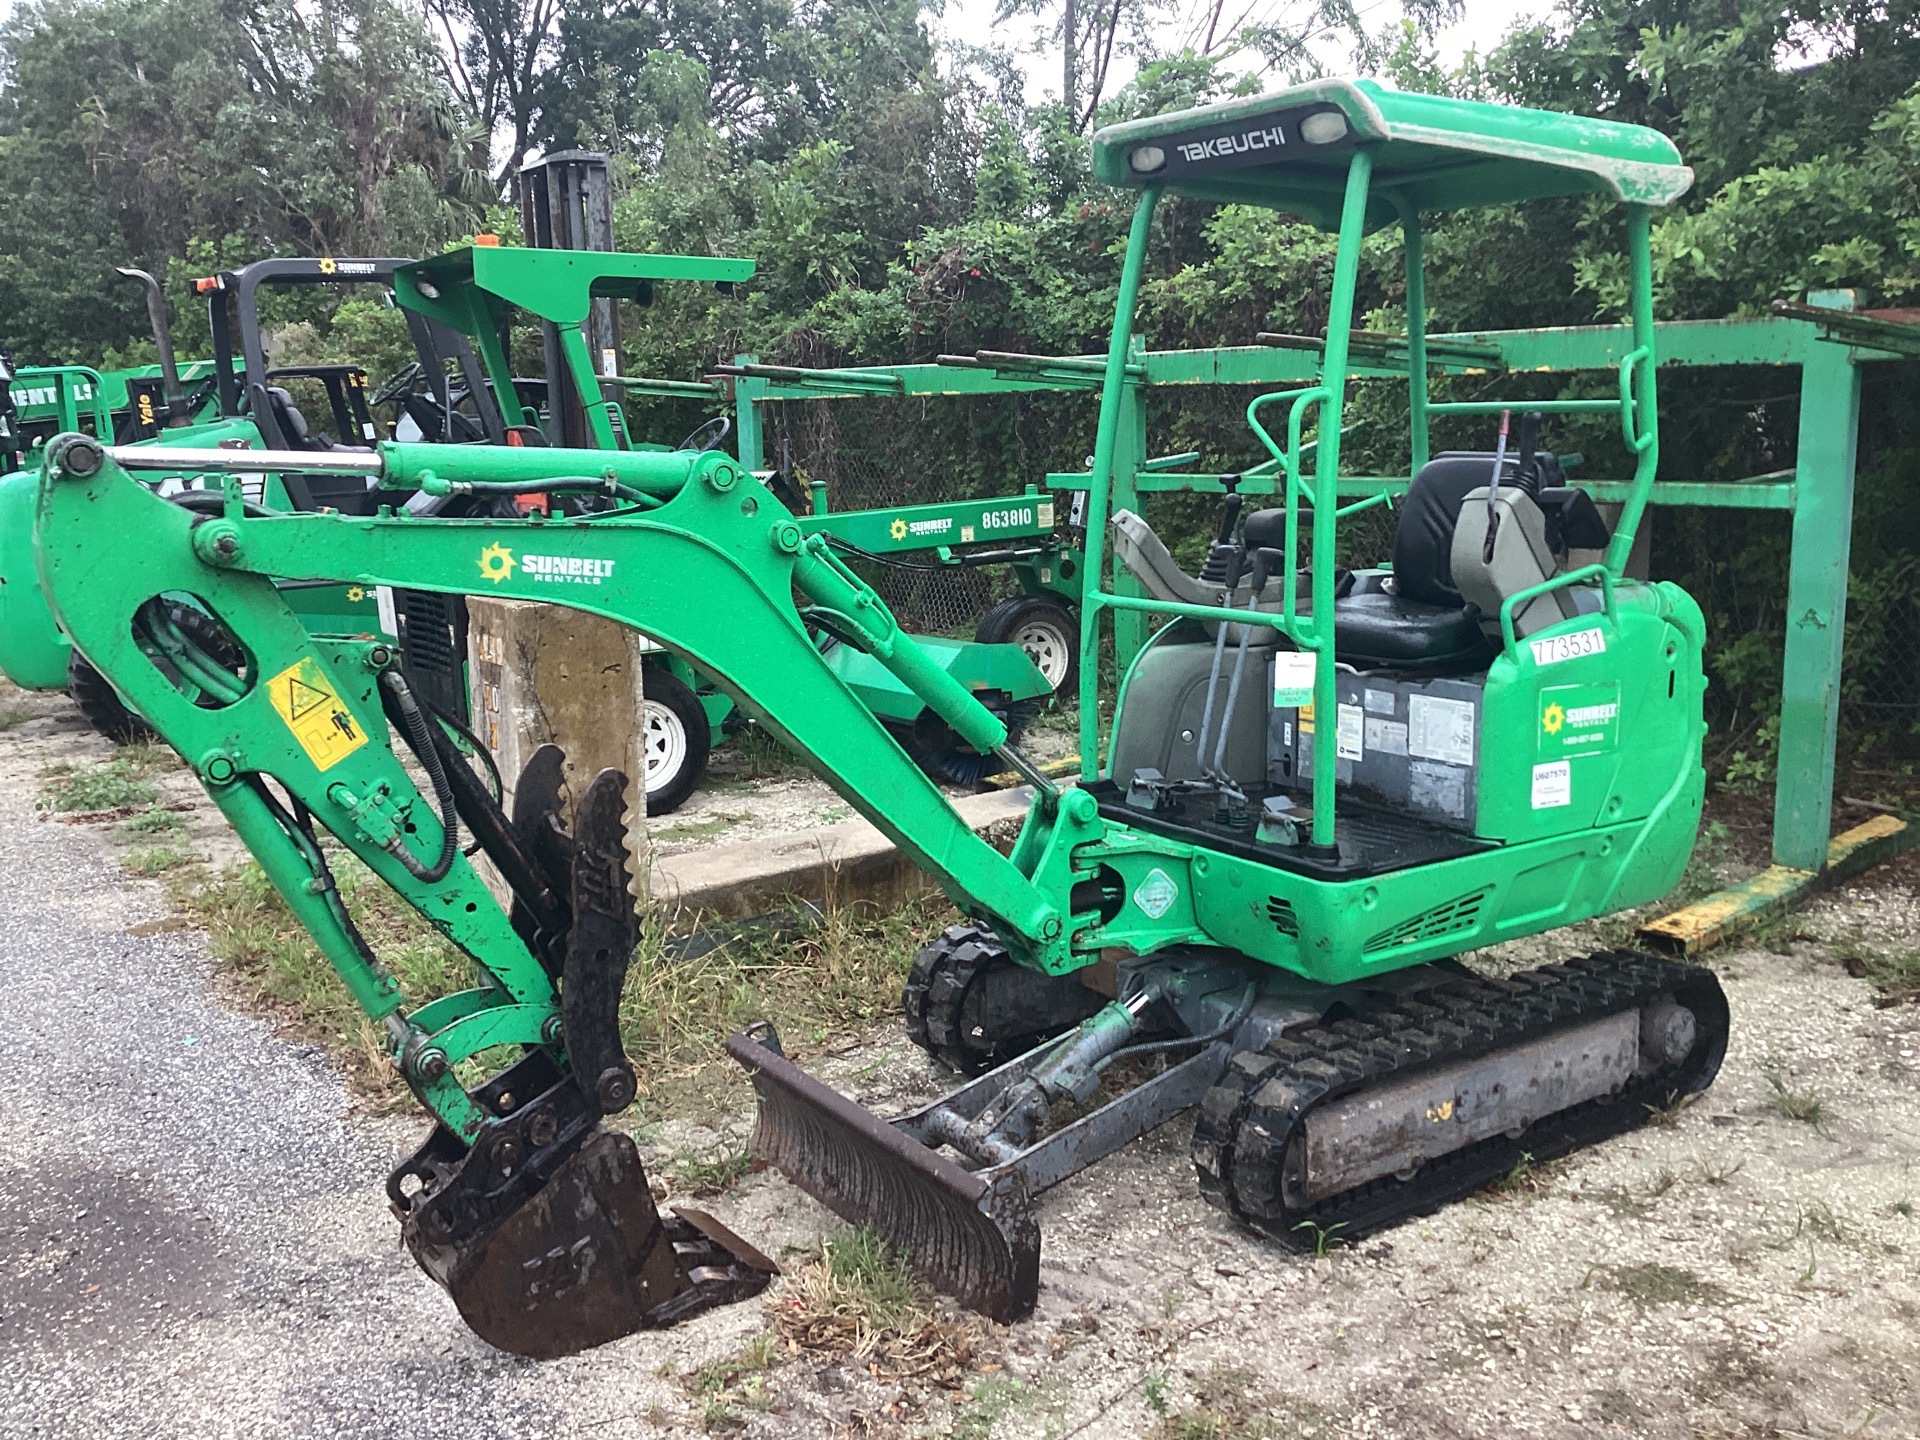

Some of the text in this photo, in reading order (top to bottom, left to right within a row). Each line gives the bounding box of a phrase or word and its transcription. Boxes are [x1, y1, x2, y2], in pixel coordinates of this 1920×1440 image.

[1177, 126, 1286, 162] TAKEUCHI
[909, 518, 953, 533] SUNBELT
[982, 508, 1032, 529] 863810
[916, 528, 947, 536] RENTALS
[521, 554, 616, 577] SUNBELT
[533, 574, 602, 585] RENTALS
[1533, 630, 1602, 663] 773531
[1566, 703, 1617, 724] SUNBELT
